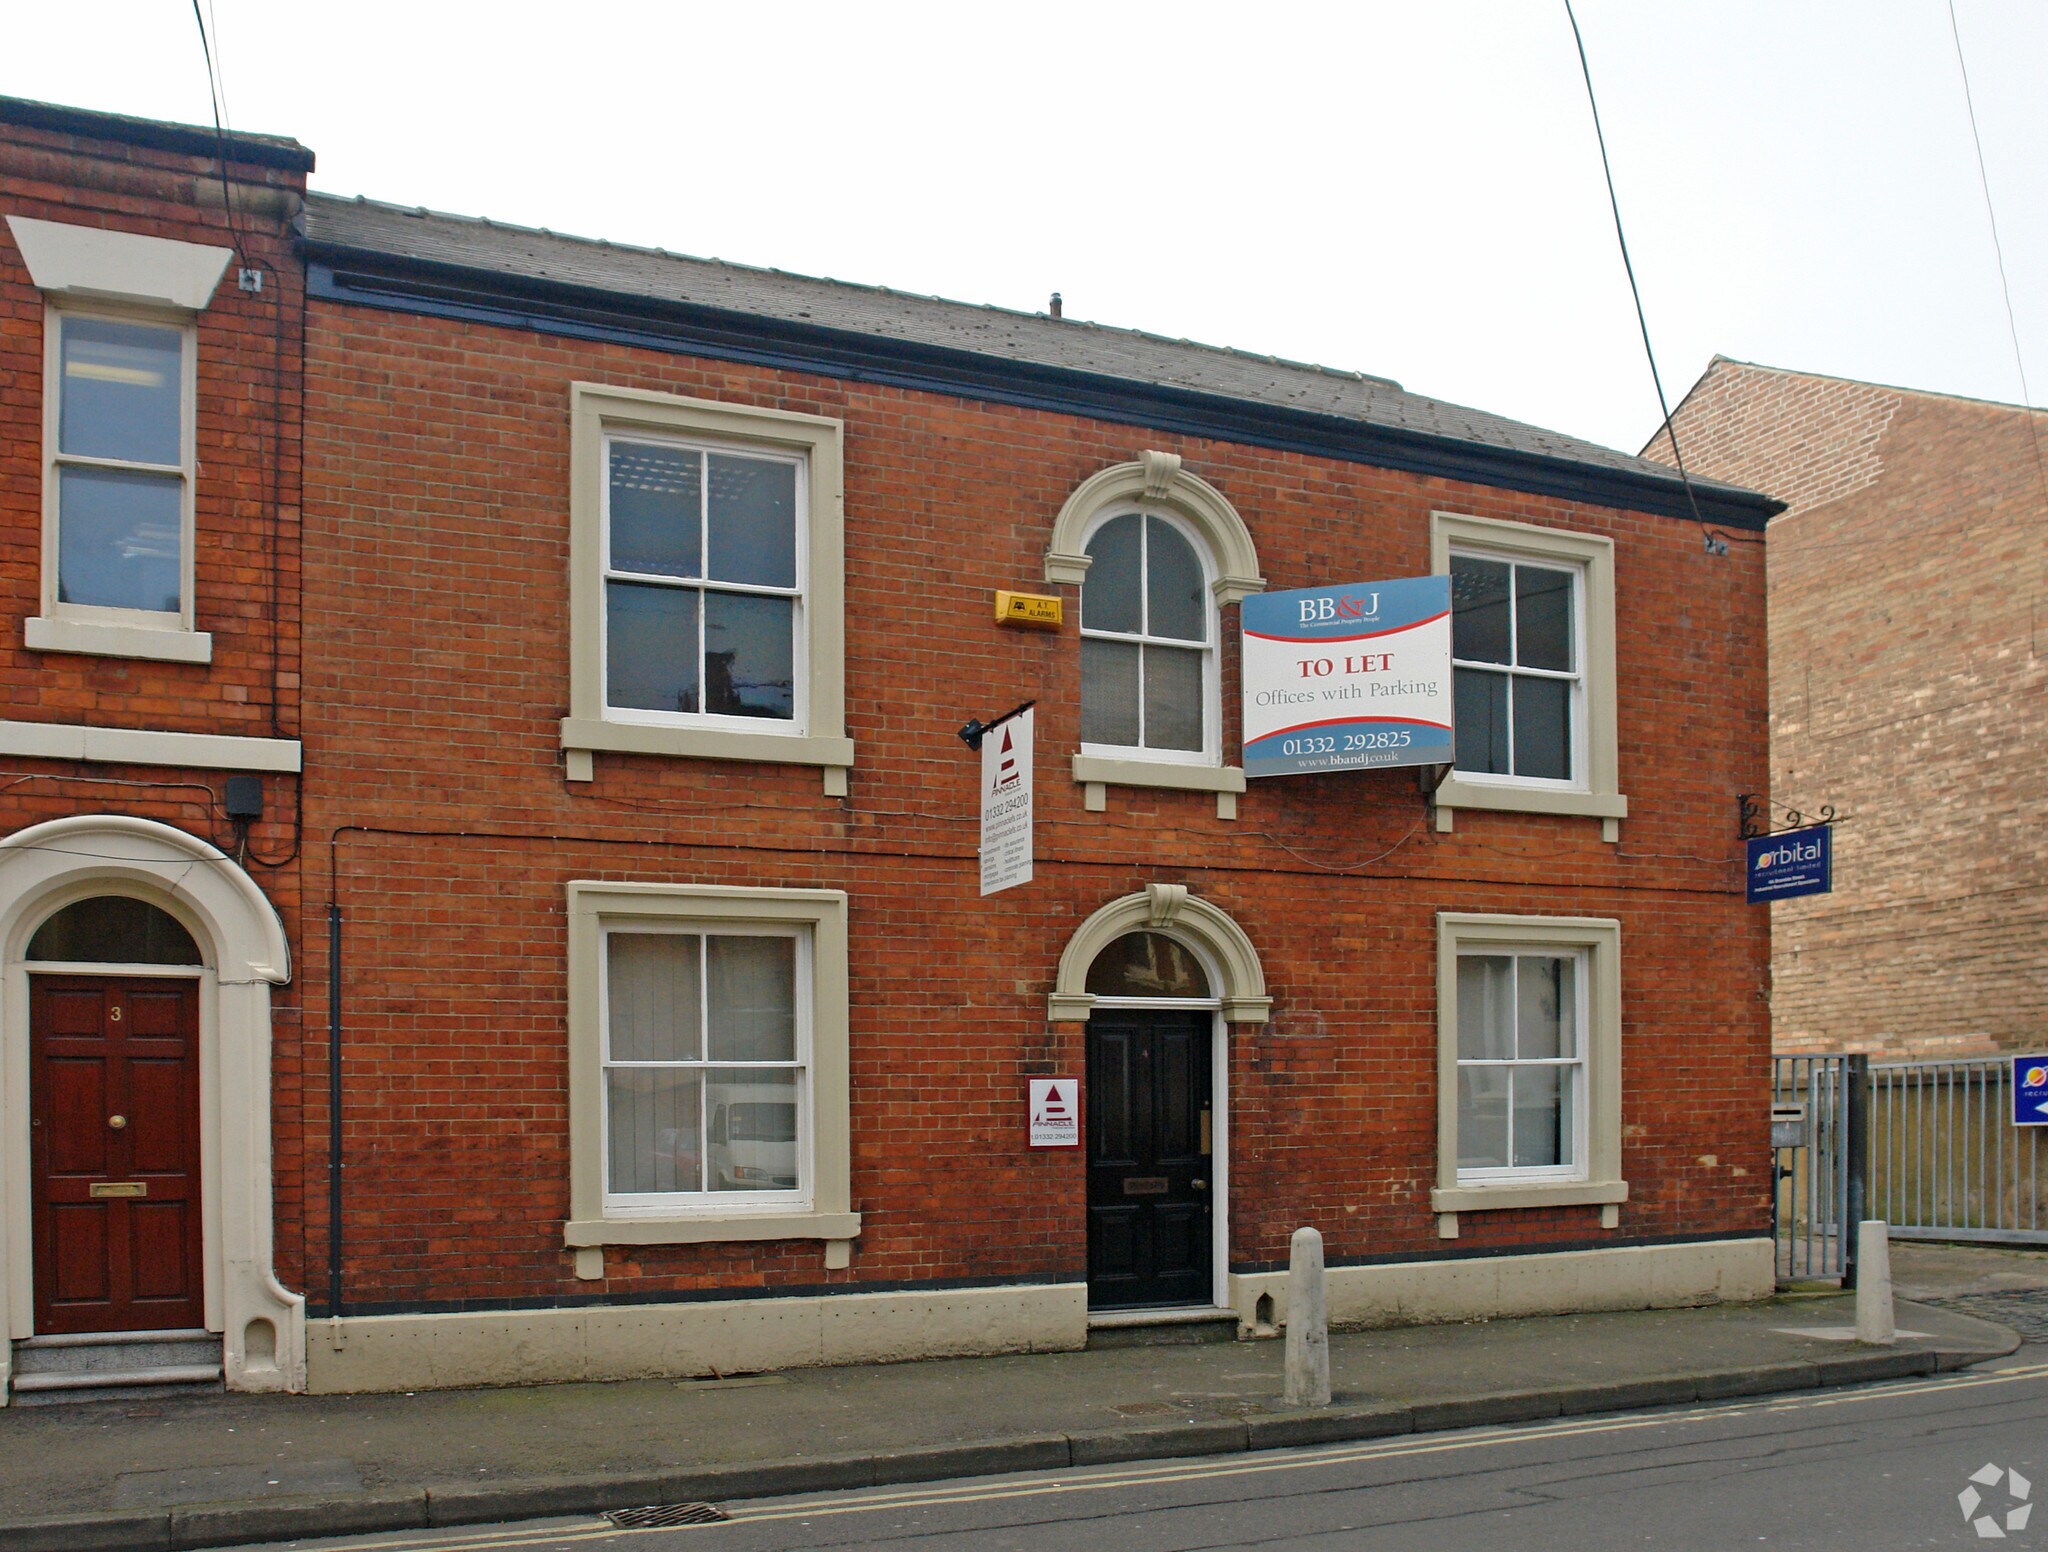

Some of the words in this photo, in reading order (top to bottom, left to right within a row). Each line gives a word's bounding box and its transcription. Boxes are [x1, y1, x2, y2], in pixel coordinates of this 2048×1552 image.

[1028, 609, 1056, 618] ALARMS
[1298, 592, 1380, 622] BB&J
[1297, 658, 1333, 678] TO
[1344, 653, 1394, 674] LET
[1256, 688, 1315, 706] Offices
[1322, 683, 1362, 701] with
[1370, 679, 1438, 697] Parking
[1283, 736, 1336, 756] 01332
[1344, 730, 1411, 751] 292825
[1298, 750, 1399, 768] www.bbandj.co.uk
[991, 779, 1022, 798] PINNACLE
[985, 803, 1004, 821] 01332
[1005, 792, 1029, 813] 294200
[110, 1006, 122, 1021] 3
[1054, 1132, 1077, 1140] 294200
